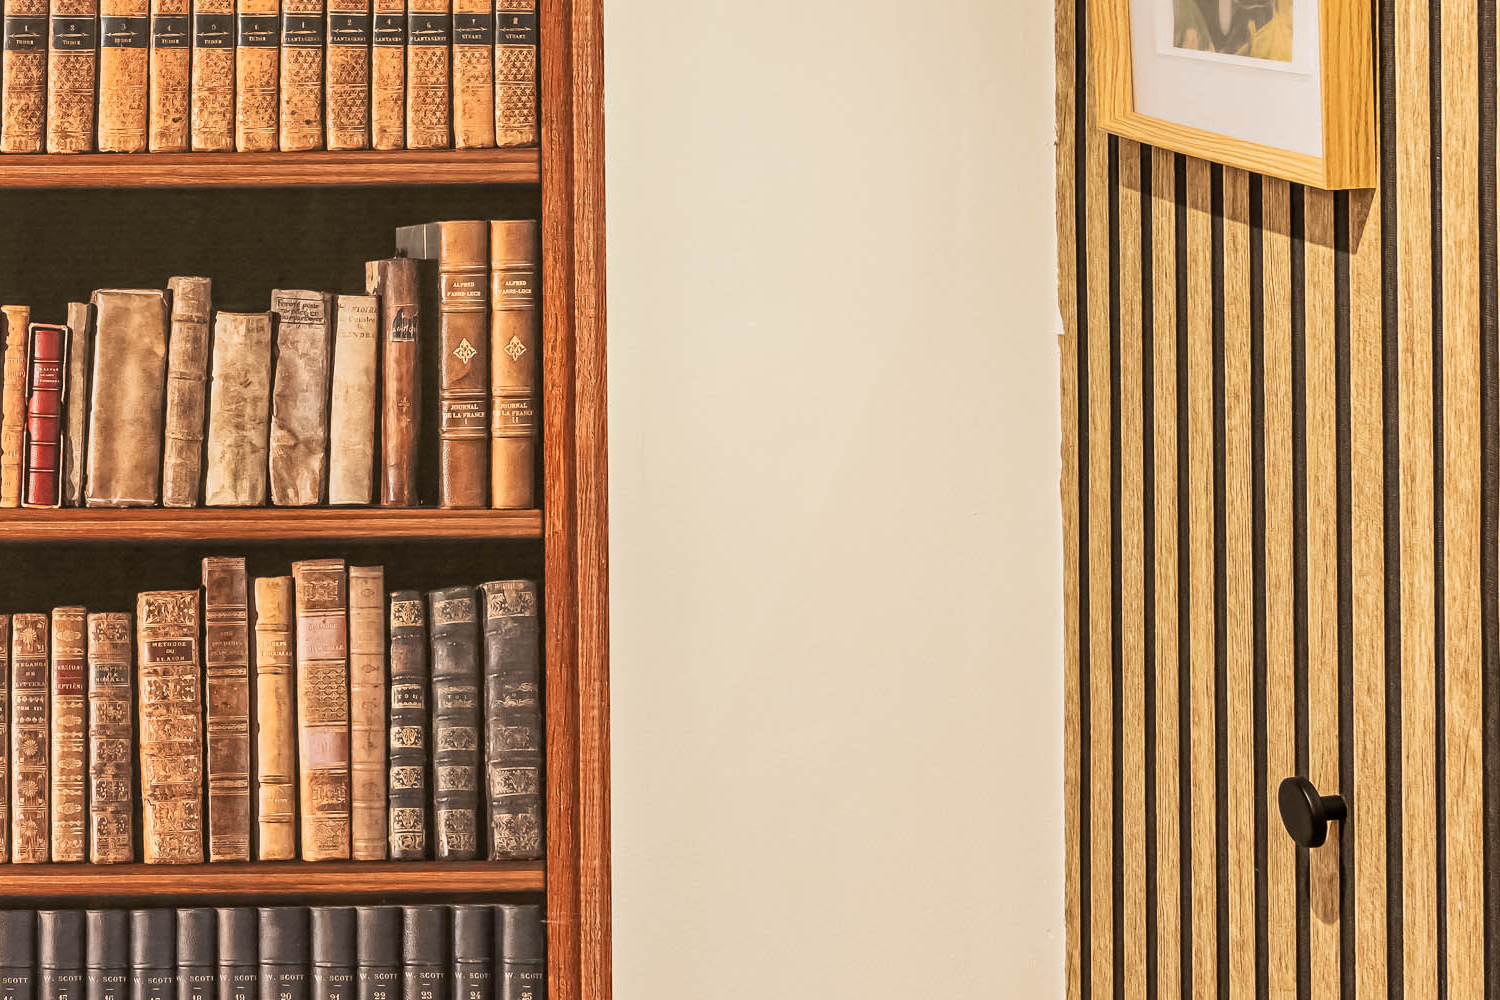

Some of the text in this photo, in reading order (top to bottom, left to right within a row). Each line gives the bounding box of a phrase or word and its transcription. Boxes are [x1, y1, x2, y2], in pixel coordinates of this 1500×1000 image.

[234, 974, 258, 982] SCOTT
[279, 973, 305, 981] SCOTT
[374, 972, 398, 980] SCOTT
[419, 971, 444, 979] SCOTT
[2, 976, 29, 984] SCOTT
